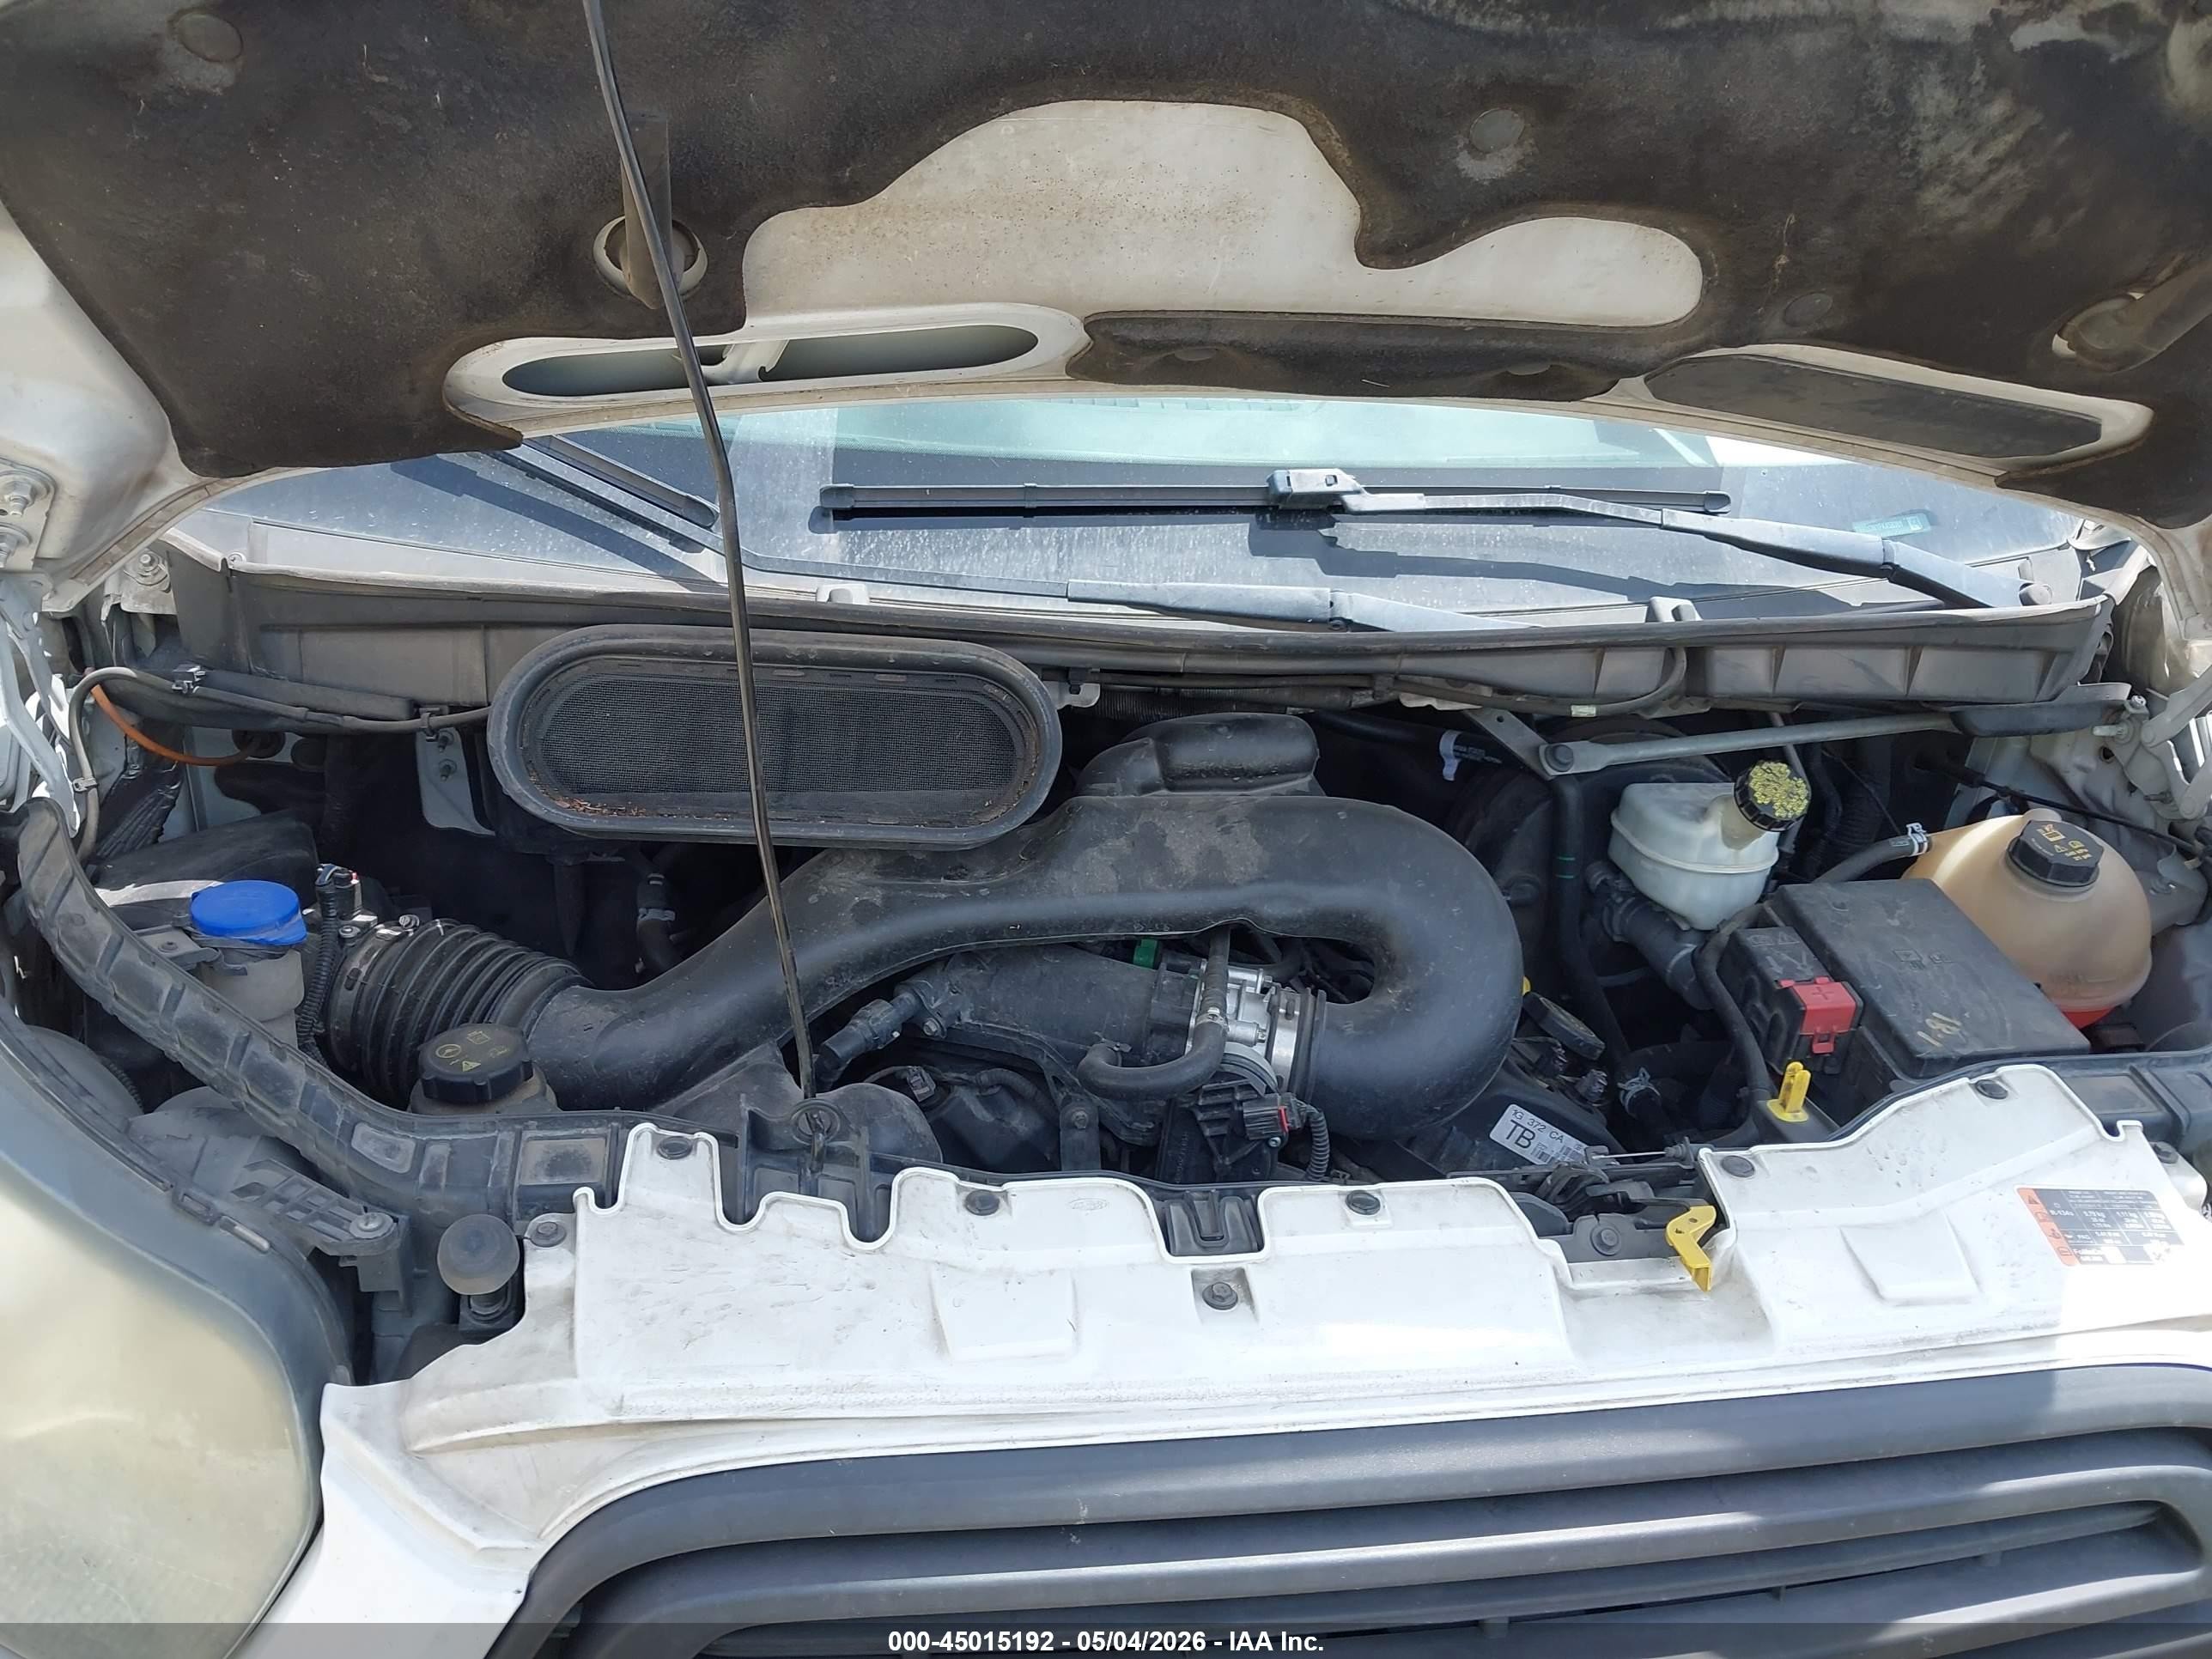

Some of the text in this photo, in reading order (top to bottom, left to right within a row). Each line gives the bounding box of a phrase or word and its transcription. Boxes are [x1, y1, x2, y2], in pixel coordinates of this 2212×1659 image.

[1505, 1119, 1536, 1149] TB
[1527, 1118, 1547, 1133] 372
[1549, 1130, 1565, 1144] CA
